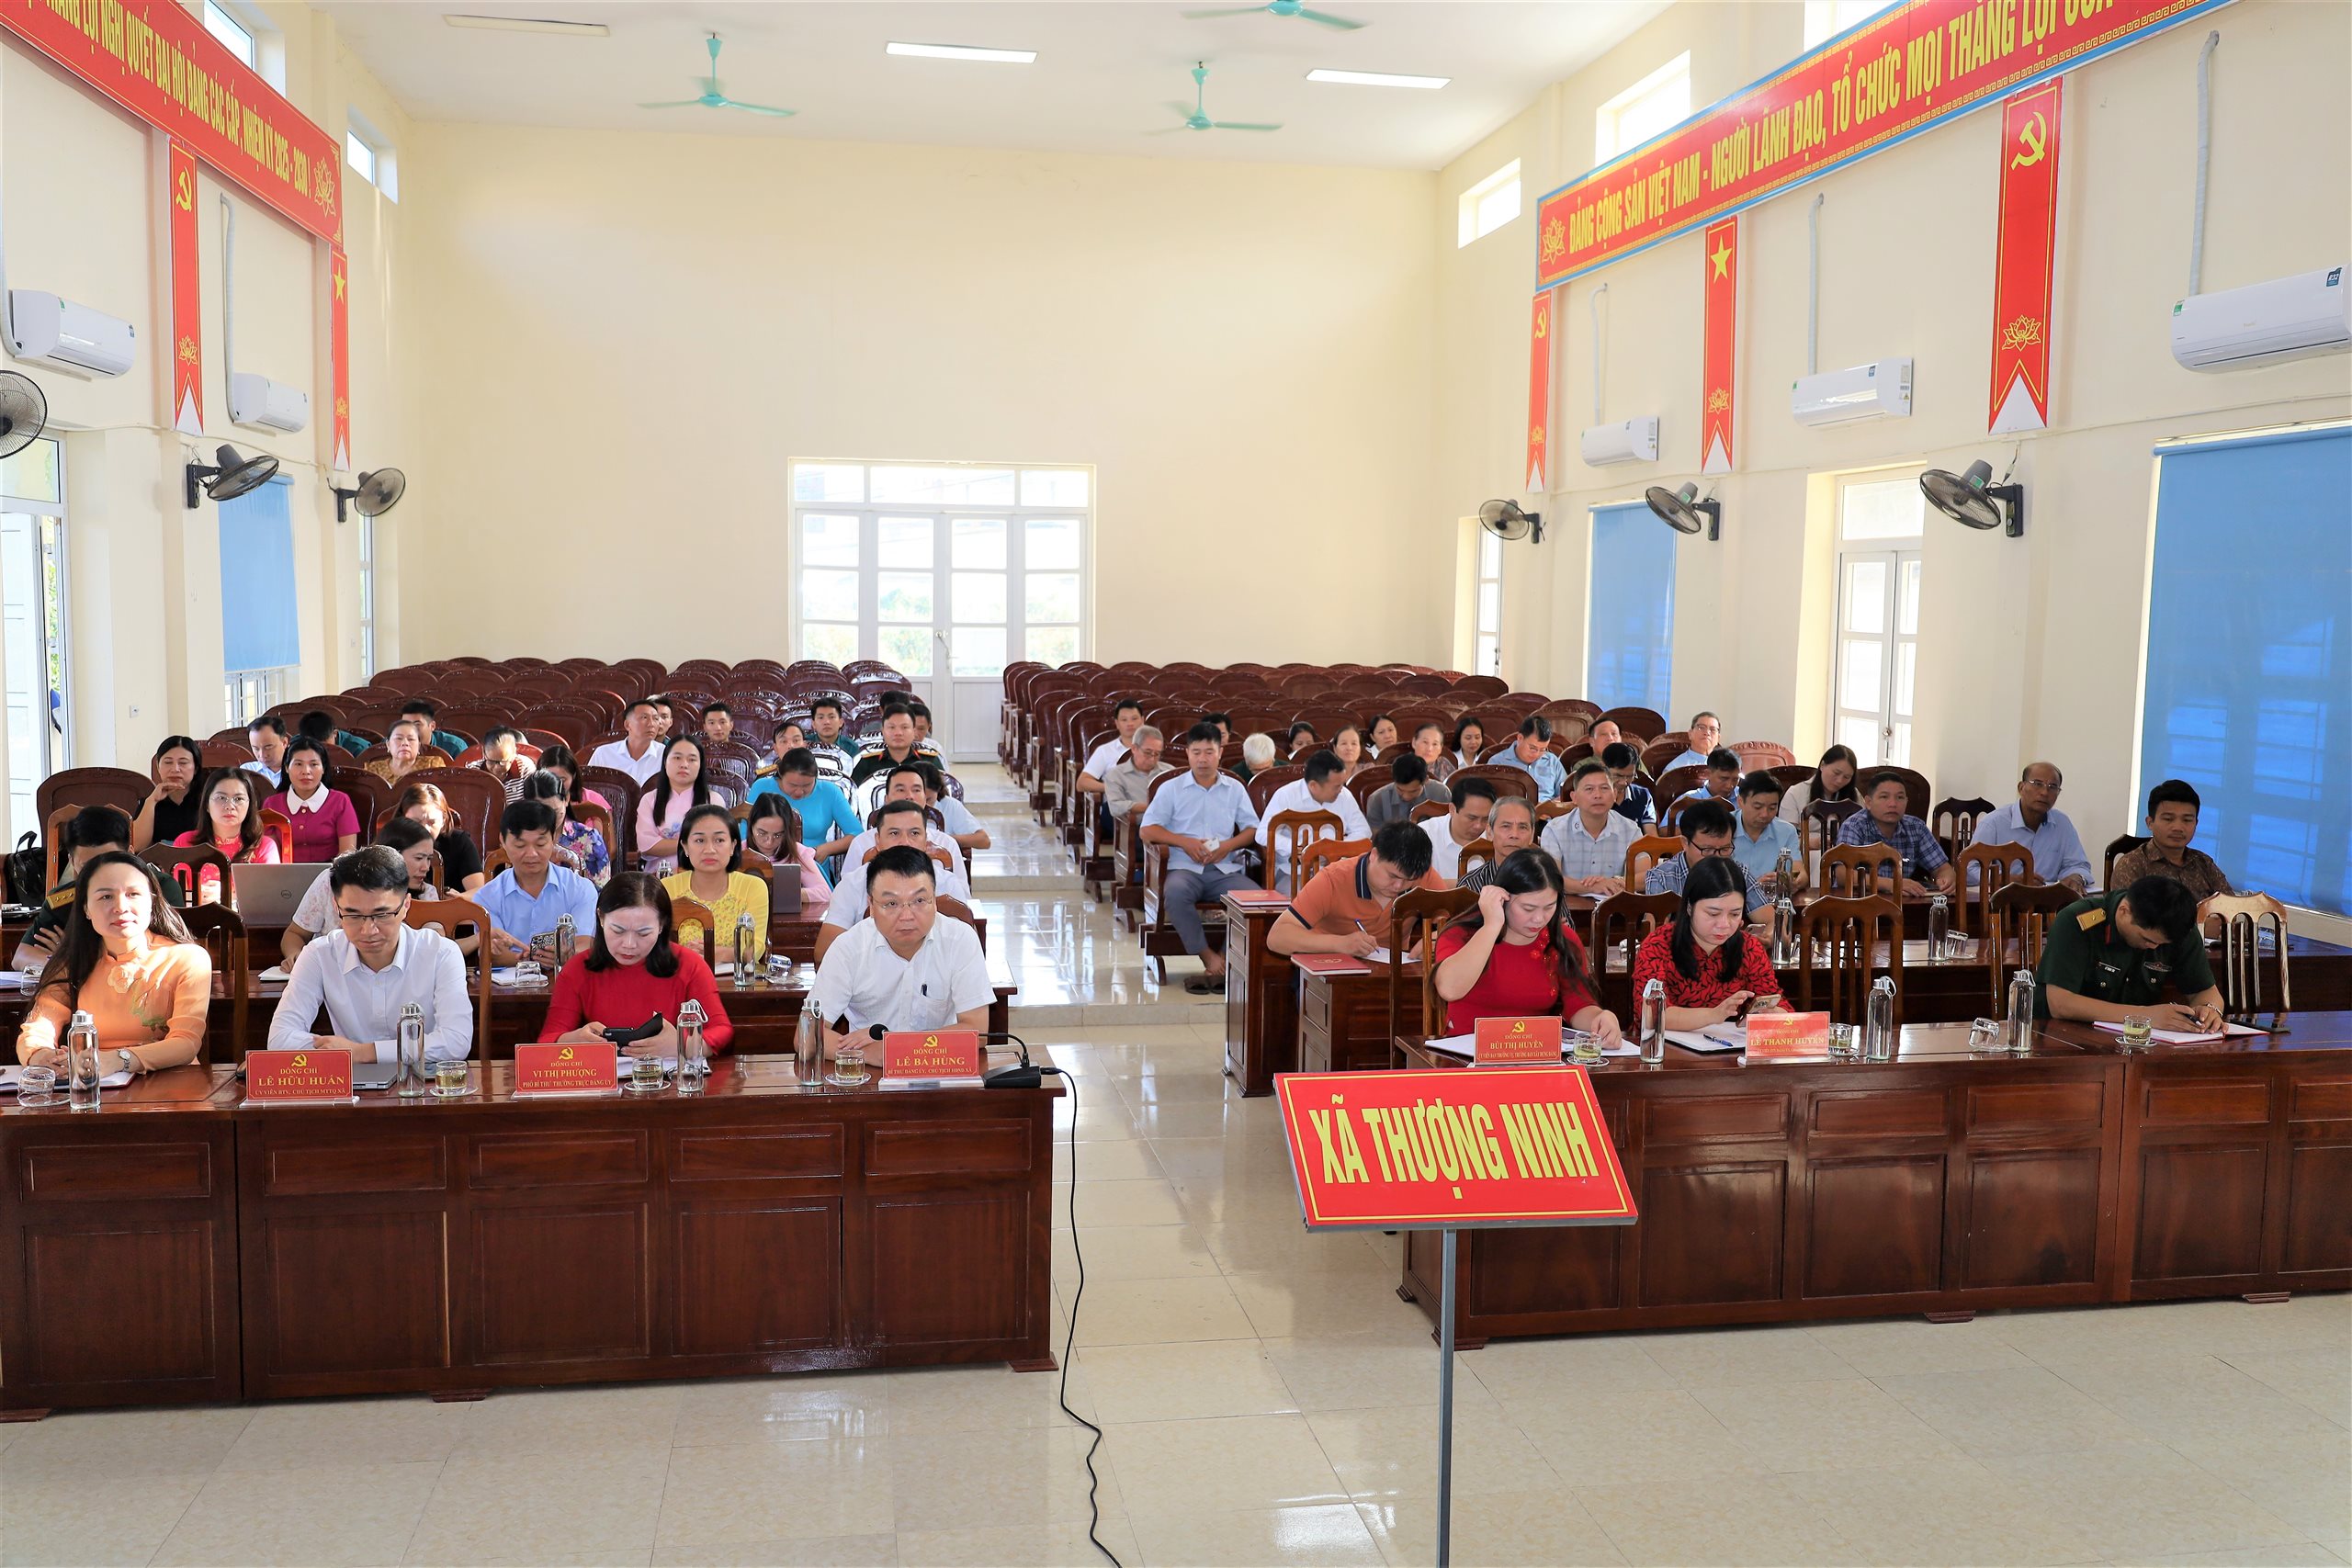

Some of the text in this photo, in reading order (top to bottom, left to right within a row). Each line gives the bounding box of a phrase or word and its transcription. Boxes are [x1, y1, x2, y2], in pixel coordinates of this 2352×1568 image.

[126, 5, 154, 84] QUYẾT
[155, 32, 171, 106] ĐẠI
[171, 39, 187, 118] HỘI
[187, 40, 209, 125] ĐẢNG
[209, 71, 225, 137] CÁC
[1569, 196, 1594, 254] ĐẢNG
[1596, 186, 1623, 250] CỘNG
[1624, 167, 1646, 231] SẢN
[1648, 159, 1671, 227] VIỆT
[1673, 151, 1701, 209] NAM
[1711, 116, 1751, 192] NGƯỜI
[1753, 105, 1791, 173] LÃNH
[1792, 88, 1827, 162] ĐẠO,
[1831, 50, 1853, 137] TỔ
[1855, 41, 1901, 126] CHỨC
[1905, 26, 1943, 107] MỌI
[1504, 1042, 1517, 1051] THỊ
[1763, 1037, 1793, 1045] THANH
[896, 1055, 965, 1066] LÊ BÁ HÙNG
[544, 1069, 559, 1079] THỊ
[560, 1067, 597, 1078] PHƯỢNG
[258, 1076, 275, 1087] LÊ
[278, 1076, 306, 1086] HỮU
[1308, 1093, 1600, 1200] XÃ THƯỢNG NINH
